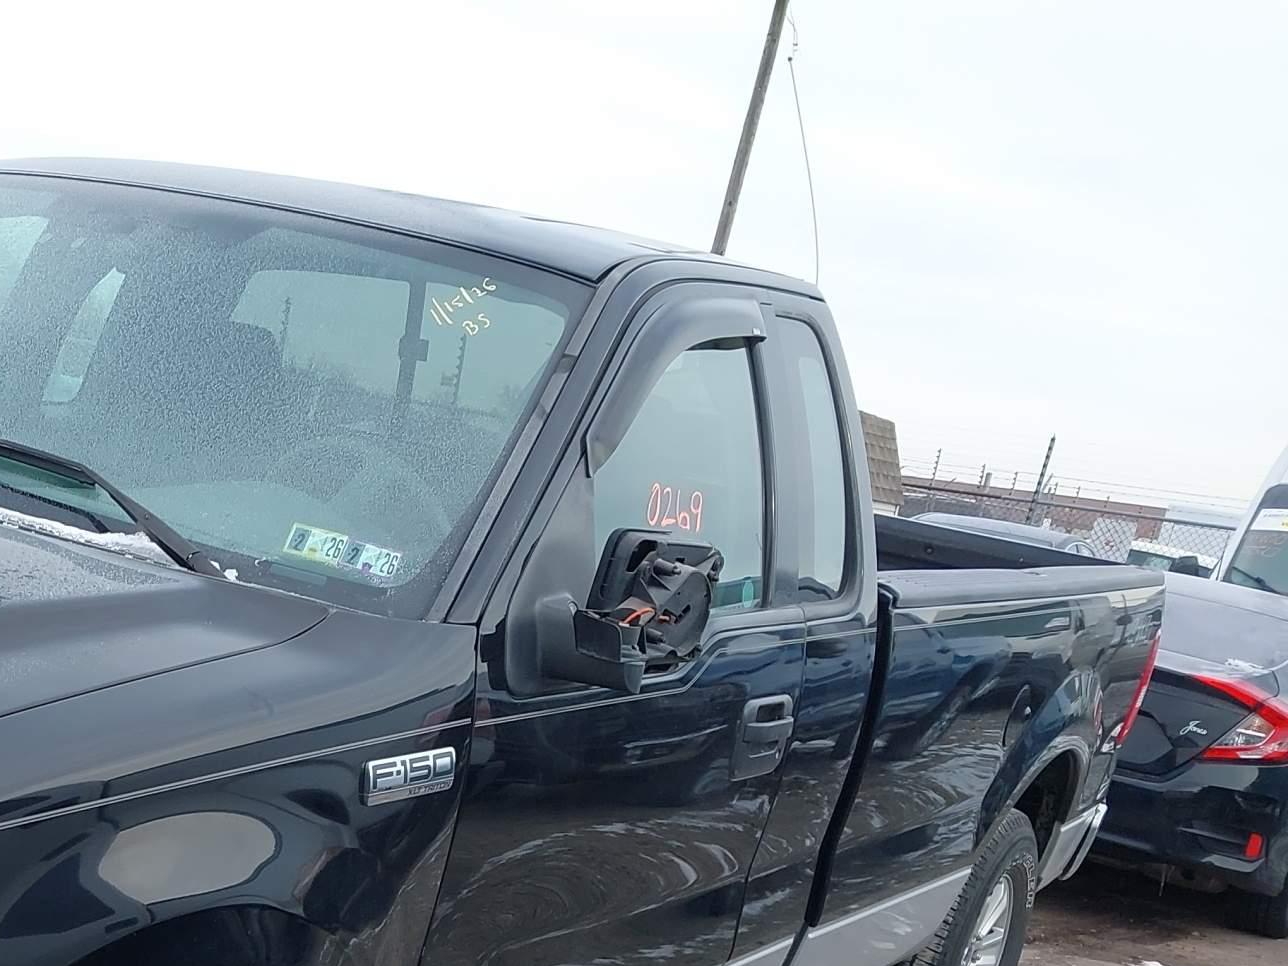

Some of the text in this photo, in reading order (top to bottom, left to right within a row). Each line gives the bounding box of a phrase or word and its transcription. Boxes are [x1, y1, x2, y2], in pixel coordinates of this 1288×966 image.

[647, 482, 703, 532] 0269
[293, 533, 344, 559] 2 26
[347, 547, 399, 575] 2 26
[372, 751, 454, 792] F-150
